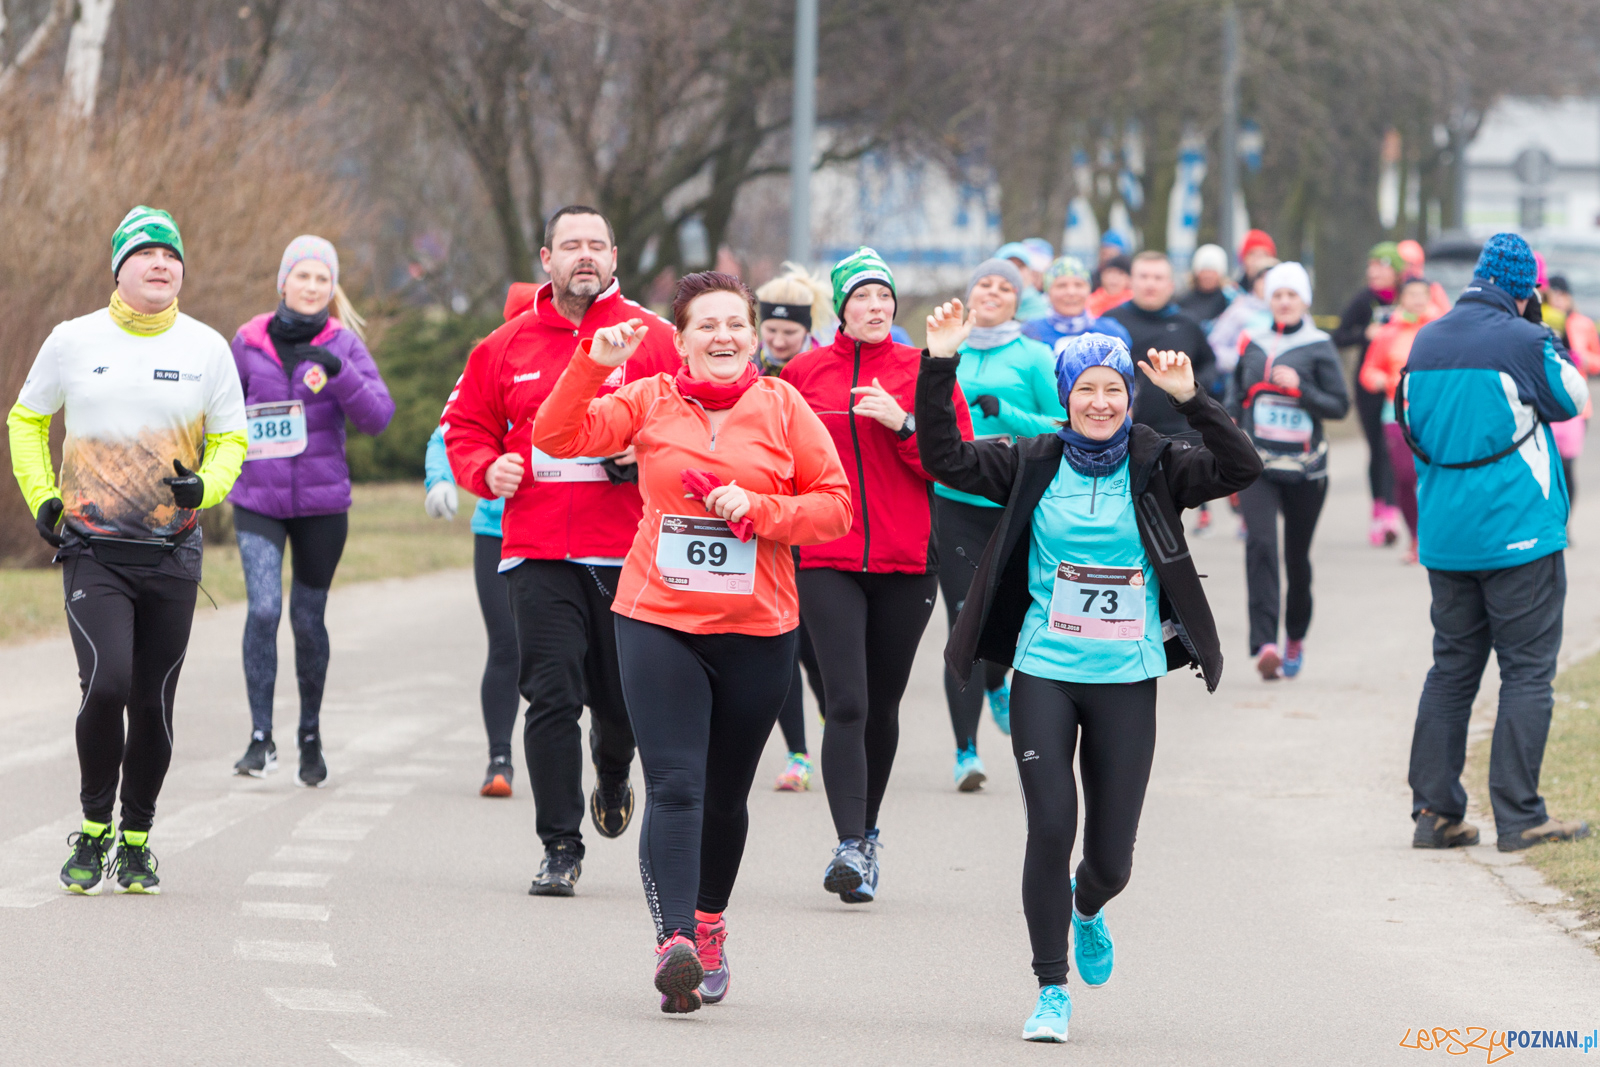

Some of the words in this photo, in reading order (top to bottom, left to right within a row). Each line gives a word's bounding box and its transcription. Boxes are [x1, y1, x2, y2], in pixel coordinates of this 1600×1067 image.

[93, 366, 109, 374] 4F
[164, 372, 178, 380] PKO
[253, 420, 292, 440] 388
[686, 540, 728, 567] 69
[1079, 588, 1119, 615] 73
[1054, 621, 1080, 632] 11.02.2018
